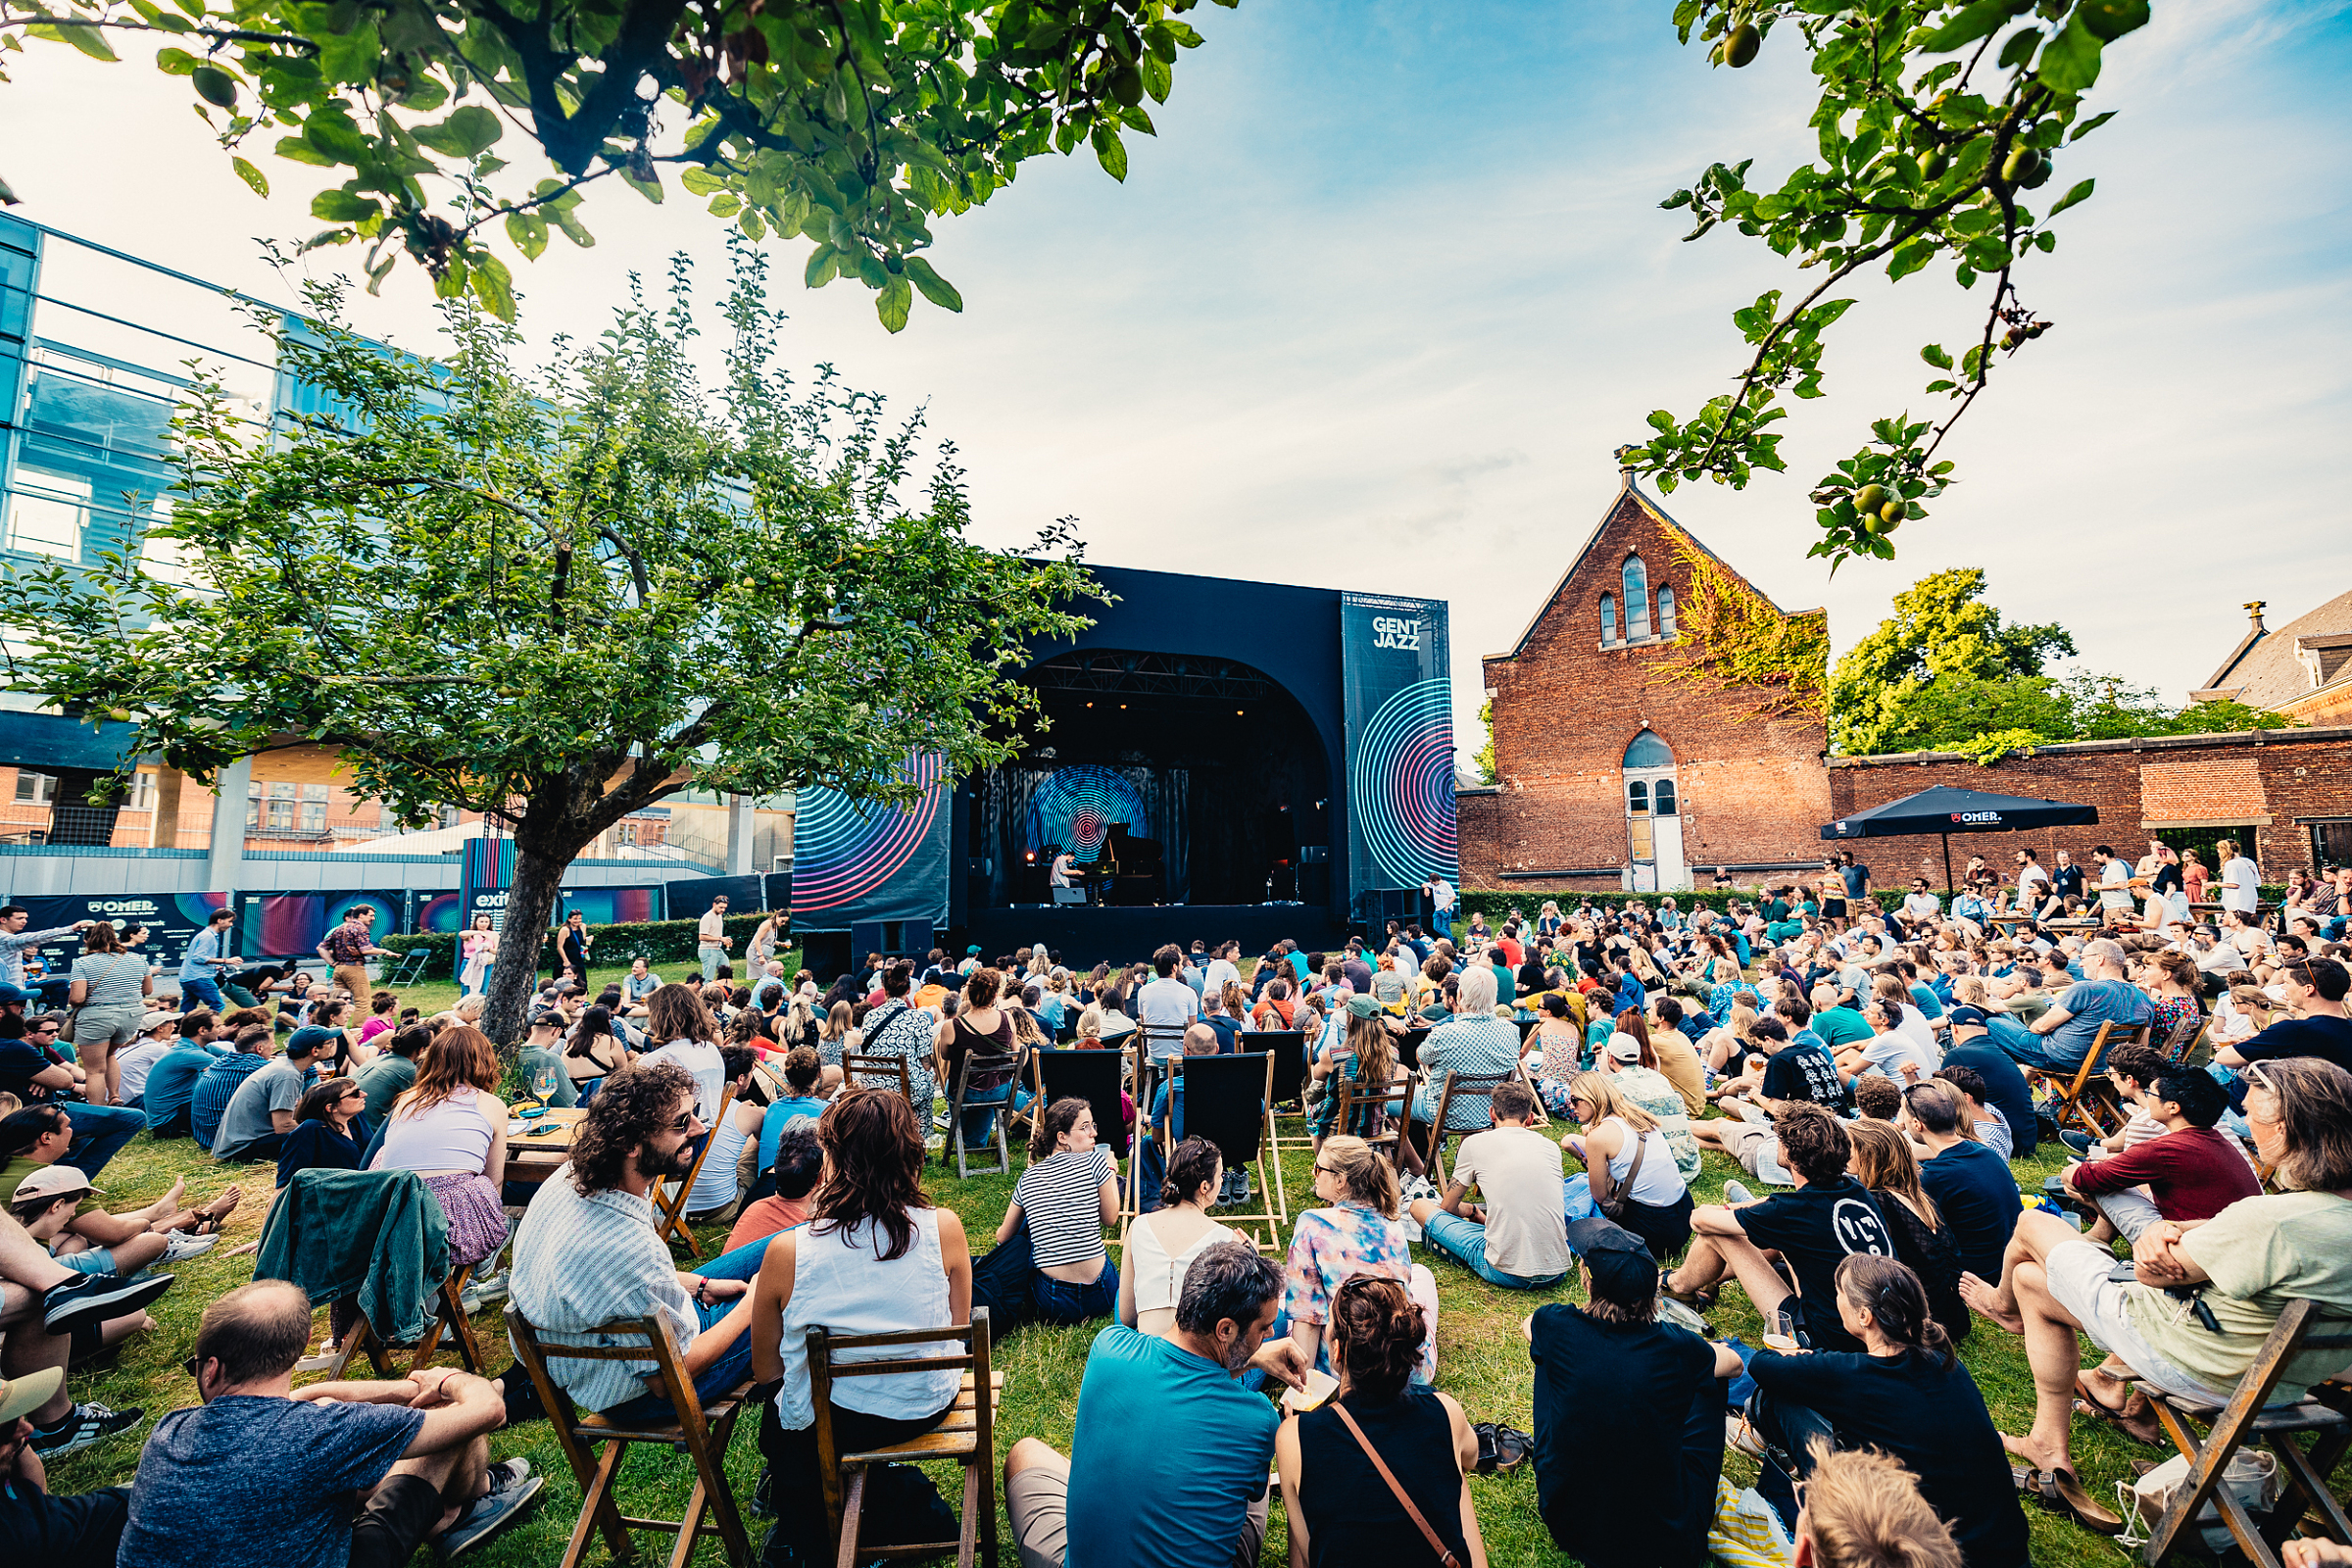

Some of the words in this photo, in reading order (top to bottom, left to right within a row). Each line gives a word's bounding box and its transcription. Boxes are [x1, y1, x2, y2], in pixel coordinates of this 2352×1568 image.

[1372, 616, 1422, 635] GENT
[1373, 632, 1420, 651] JAZZ
[1961, 810, 2003, 822] OMER.
[103, 900, 159, 912] OMER.
[475, 890, 511, 907] exit
